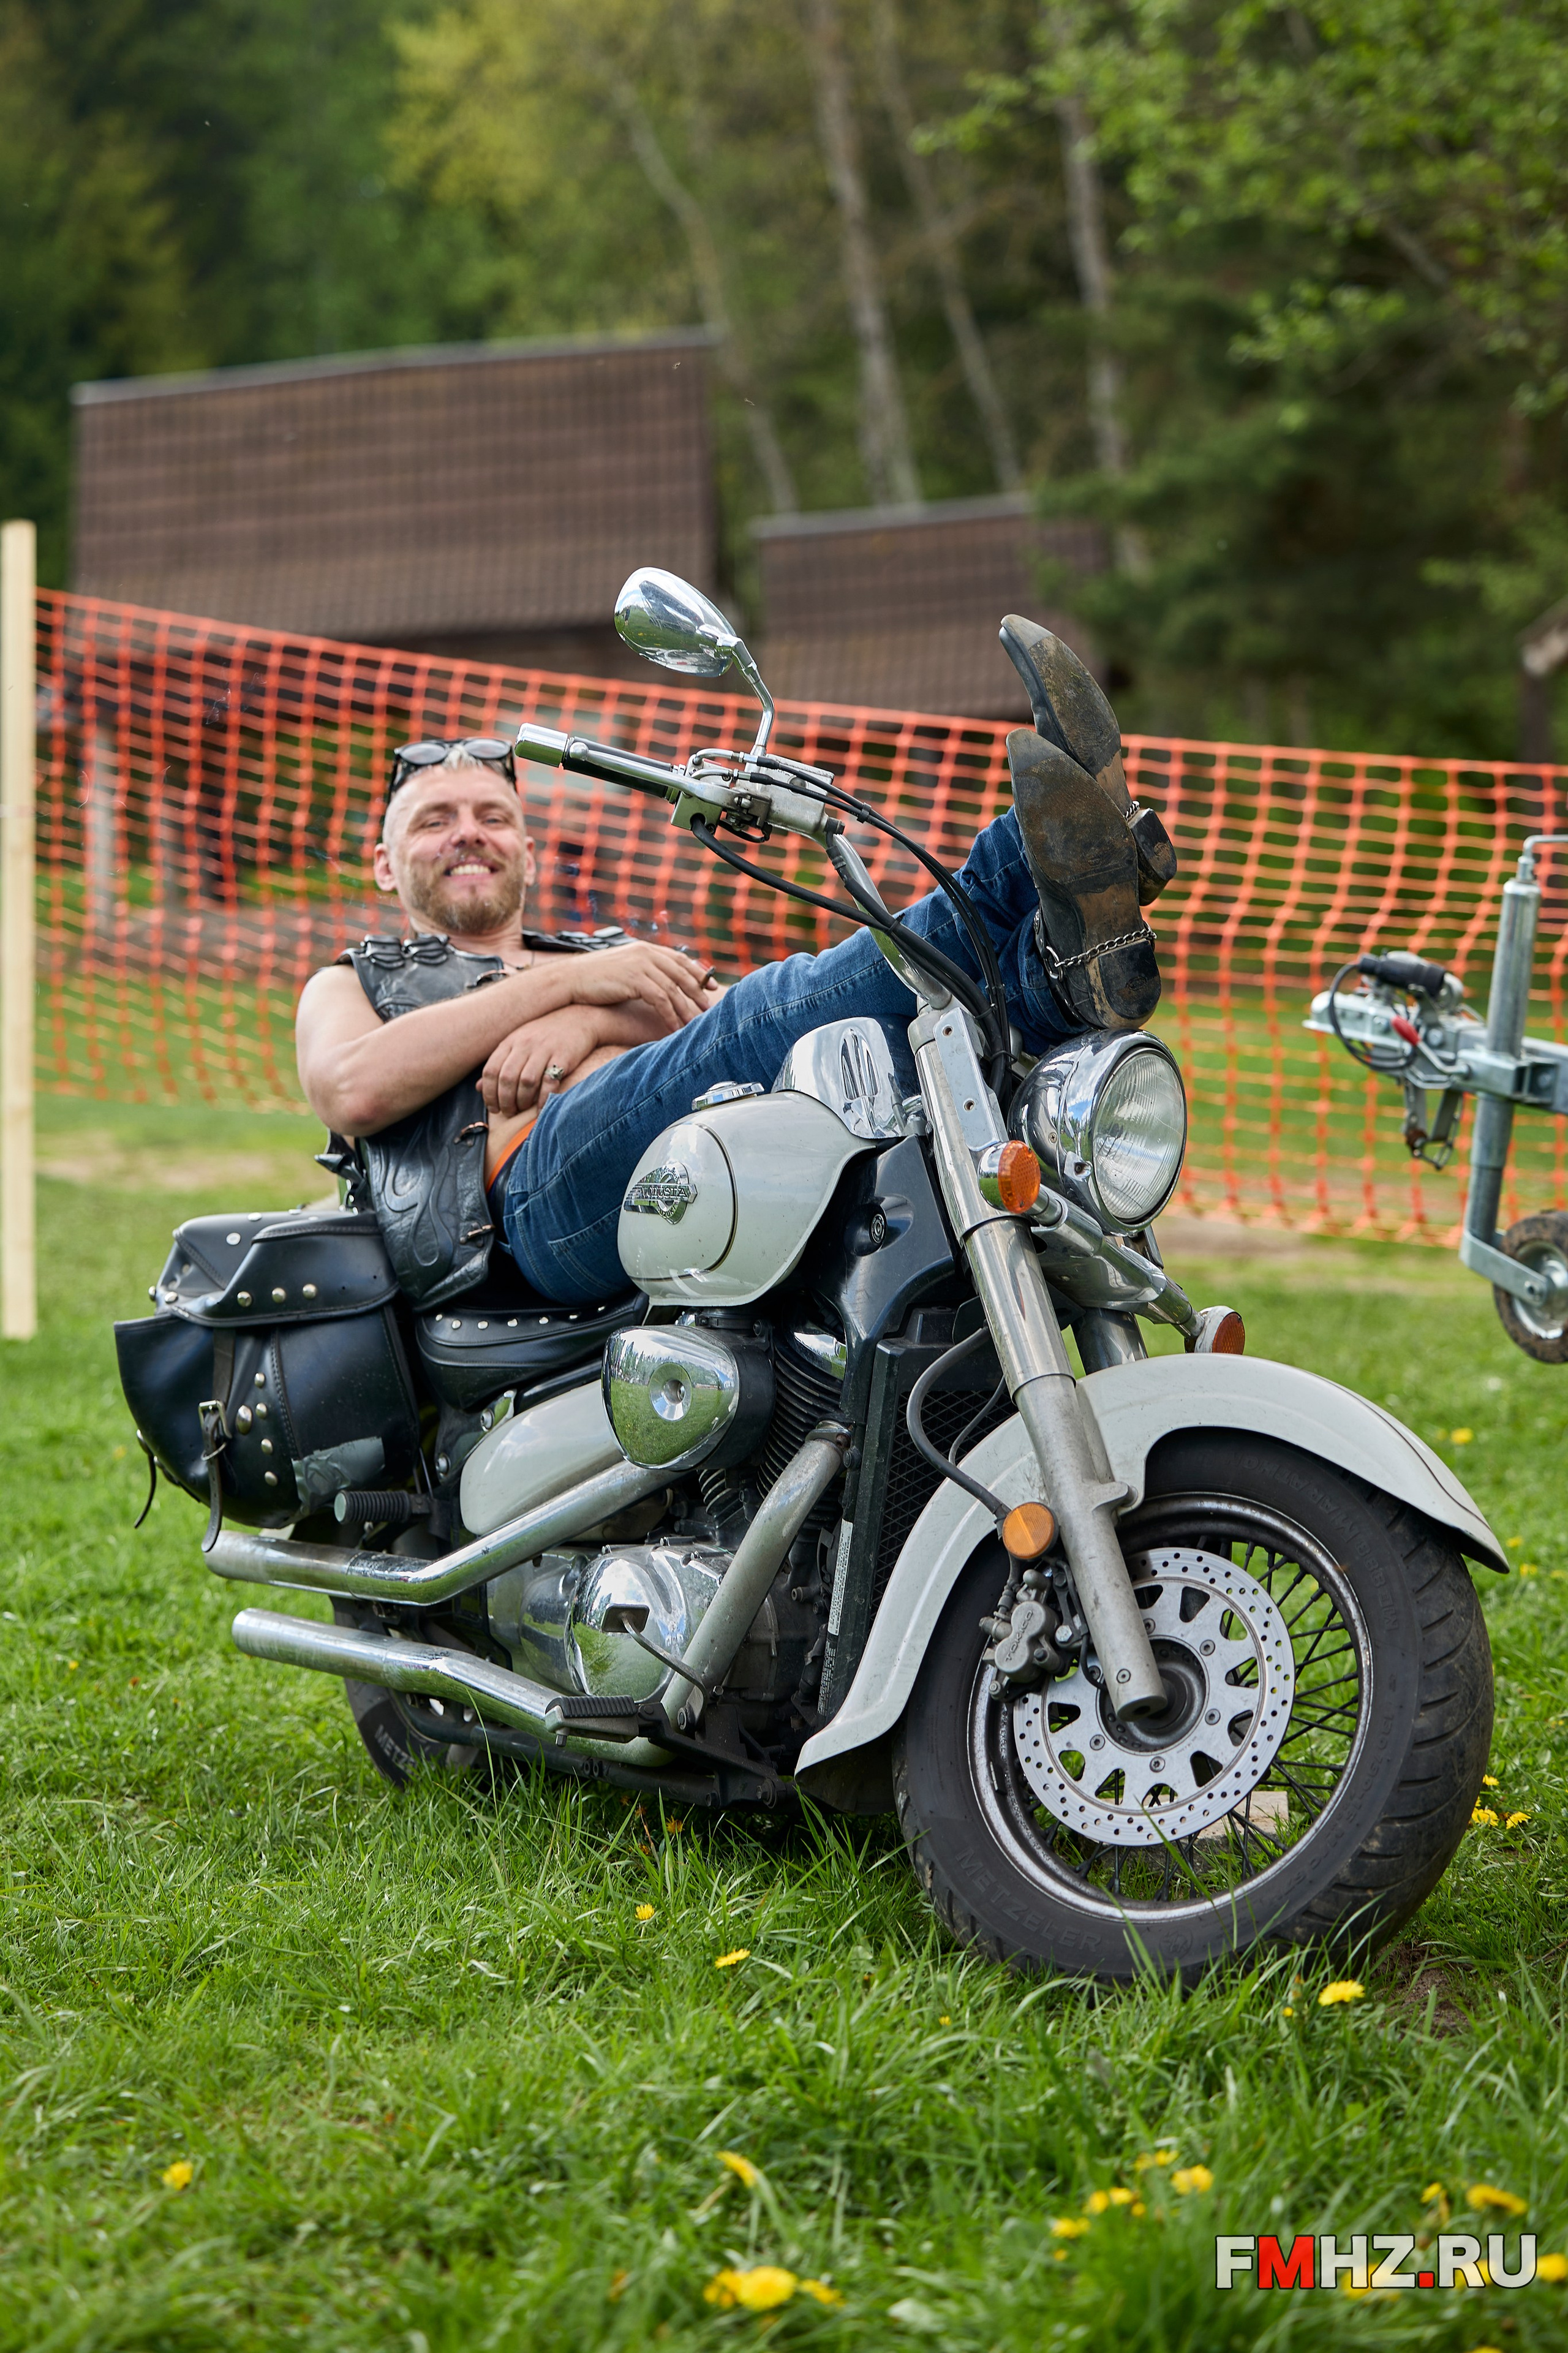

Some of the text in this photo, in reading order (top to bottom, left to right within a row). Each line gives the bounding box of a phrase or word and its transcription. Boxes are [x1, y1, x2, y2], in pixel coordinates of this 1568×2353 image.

[657, 1204, 676, 1217] SUZUKI
[1005, 1609, 1034, 1663] TOKICO
[954, 1845, 1104, 1954] METZELER
